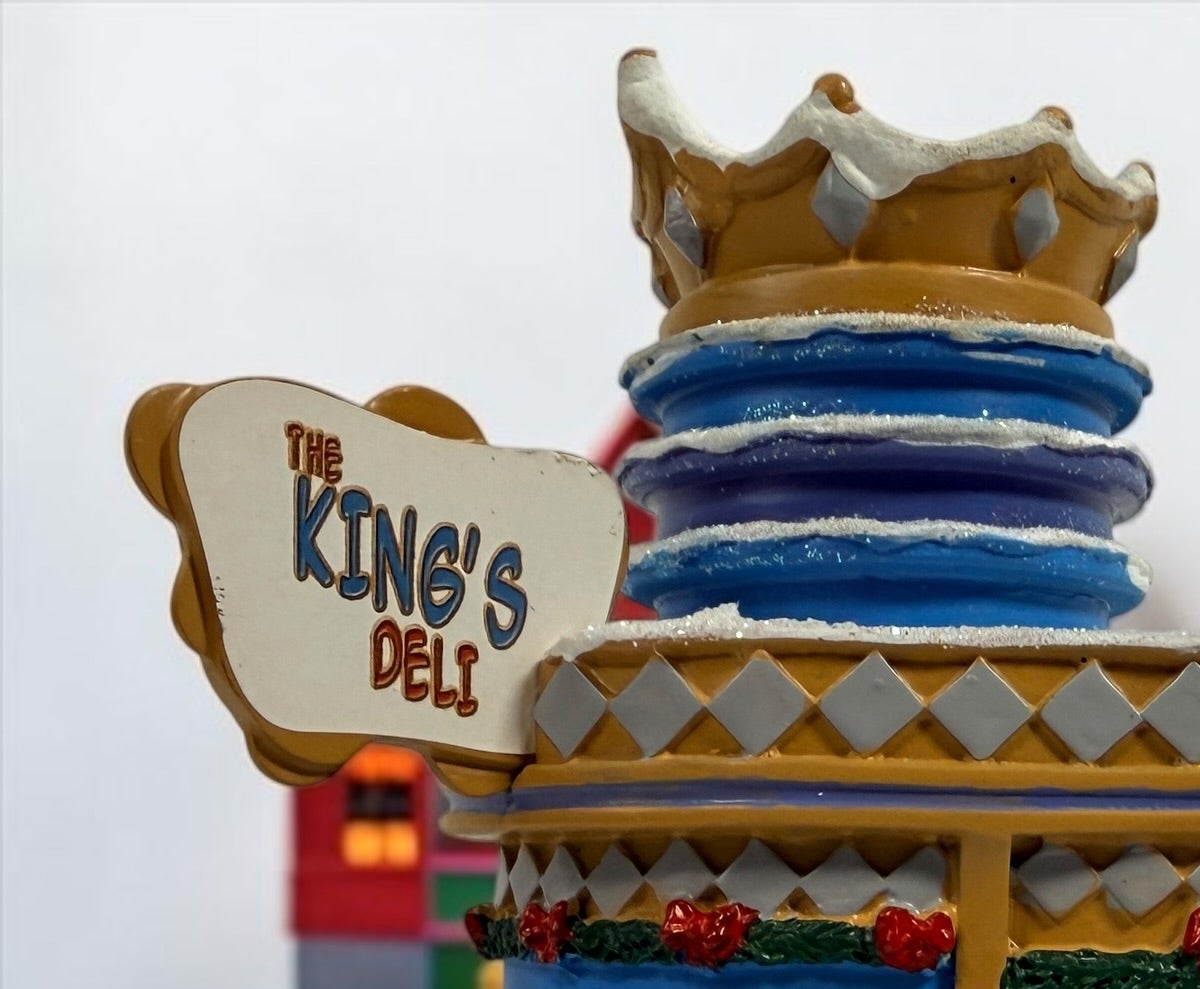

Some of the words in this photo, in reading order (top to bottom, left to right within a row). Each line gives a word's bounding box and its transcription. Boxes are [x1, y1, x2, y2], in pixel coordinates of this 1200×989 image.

[285, 421, 343, 483] THE
[293, 471, 528, 650] KING'S
[370, 617, 479, 717] DELI
